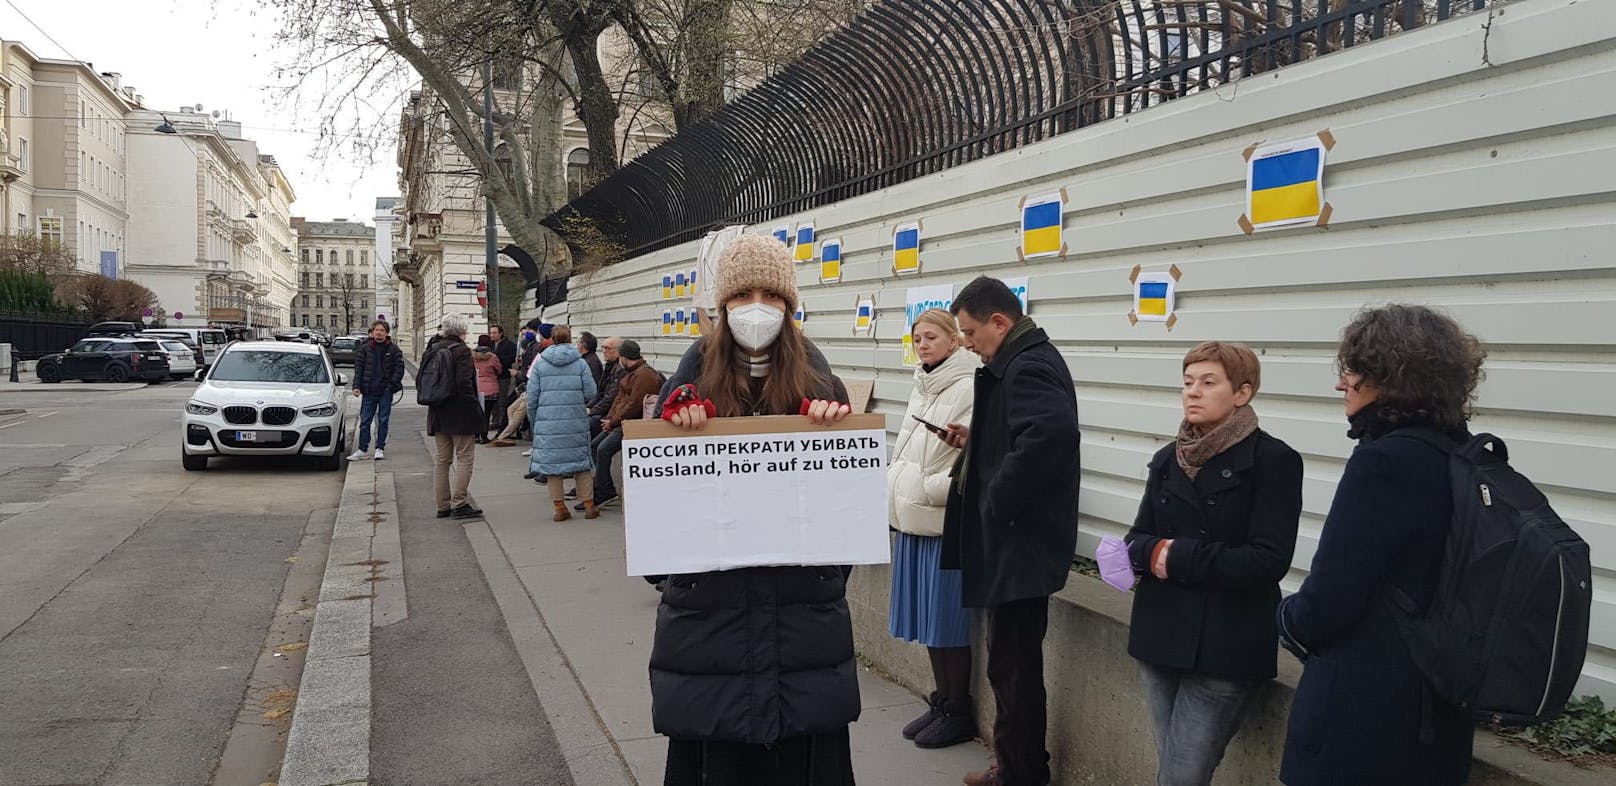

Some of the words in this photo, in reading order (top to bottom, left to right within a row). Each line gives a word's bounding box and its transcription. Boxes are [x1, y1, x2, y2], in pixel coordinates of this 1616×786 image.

[628, 444, 698, 460] РОССИЯ
[704, 440, 795, 456] ПРЕКРАТИ
[800, 436, 879, 452] УБИВАТЬ
[629, 461, 722, 478] Russland,
[728, 459, 761, 474] hör
[766, 457, 798, 473] auf
[802, 460, 824, 471] zu
[829, 455, 881, 470] töten
